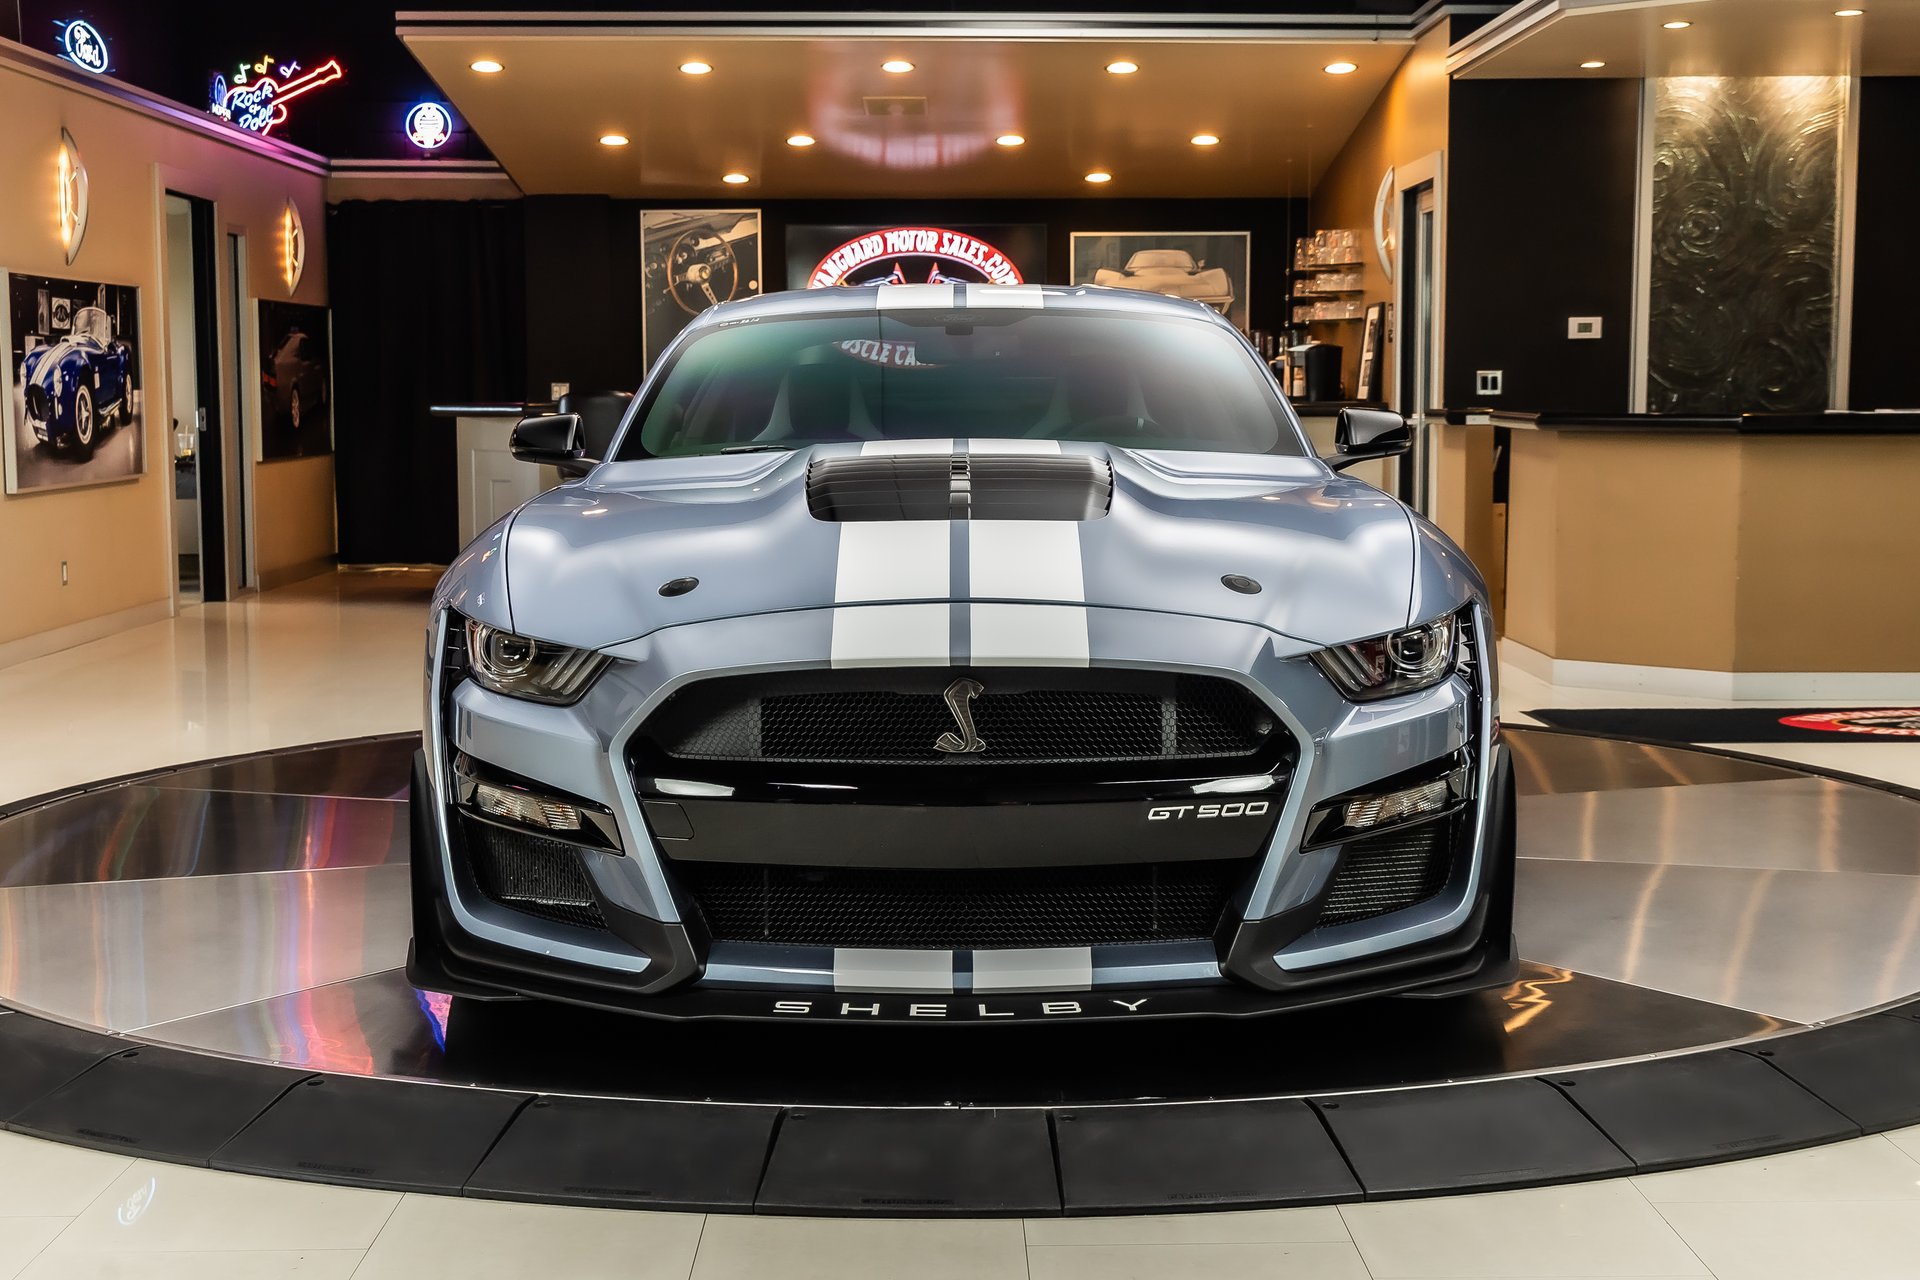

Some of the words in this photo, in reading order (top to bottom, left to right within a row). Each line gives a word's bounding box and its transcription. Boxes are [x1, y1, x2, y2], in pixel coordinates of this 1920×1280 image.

[74, 25, 102, 67] Ford
[231, 81, 274, 111] Rock
[884, 229, 938, 254] MOTOR
[1147, 805, 1195, 820] GT
[1197, 801, 1269, 819] 500
[773, 998, 1148, 1017] SHELBY
